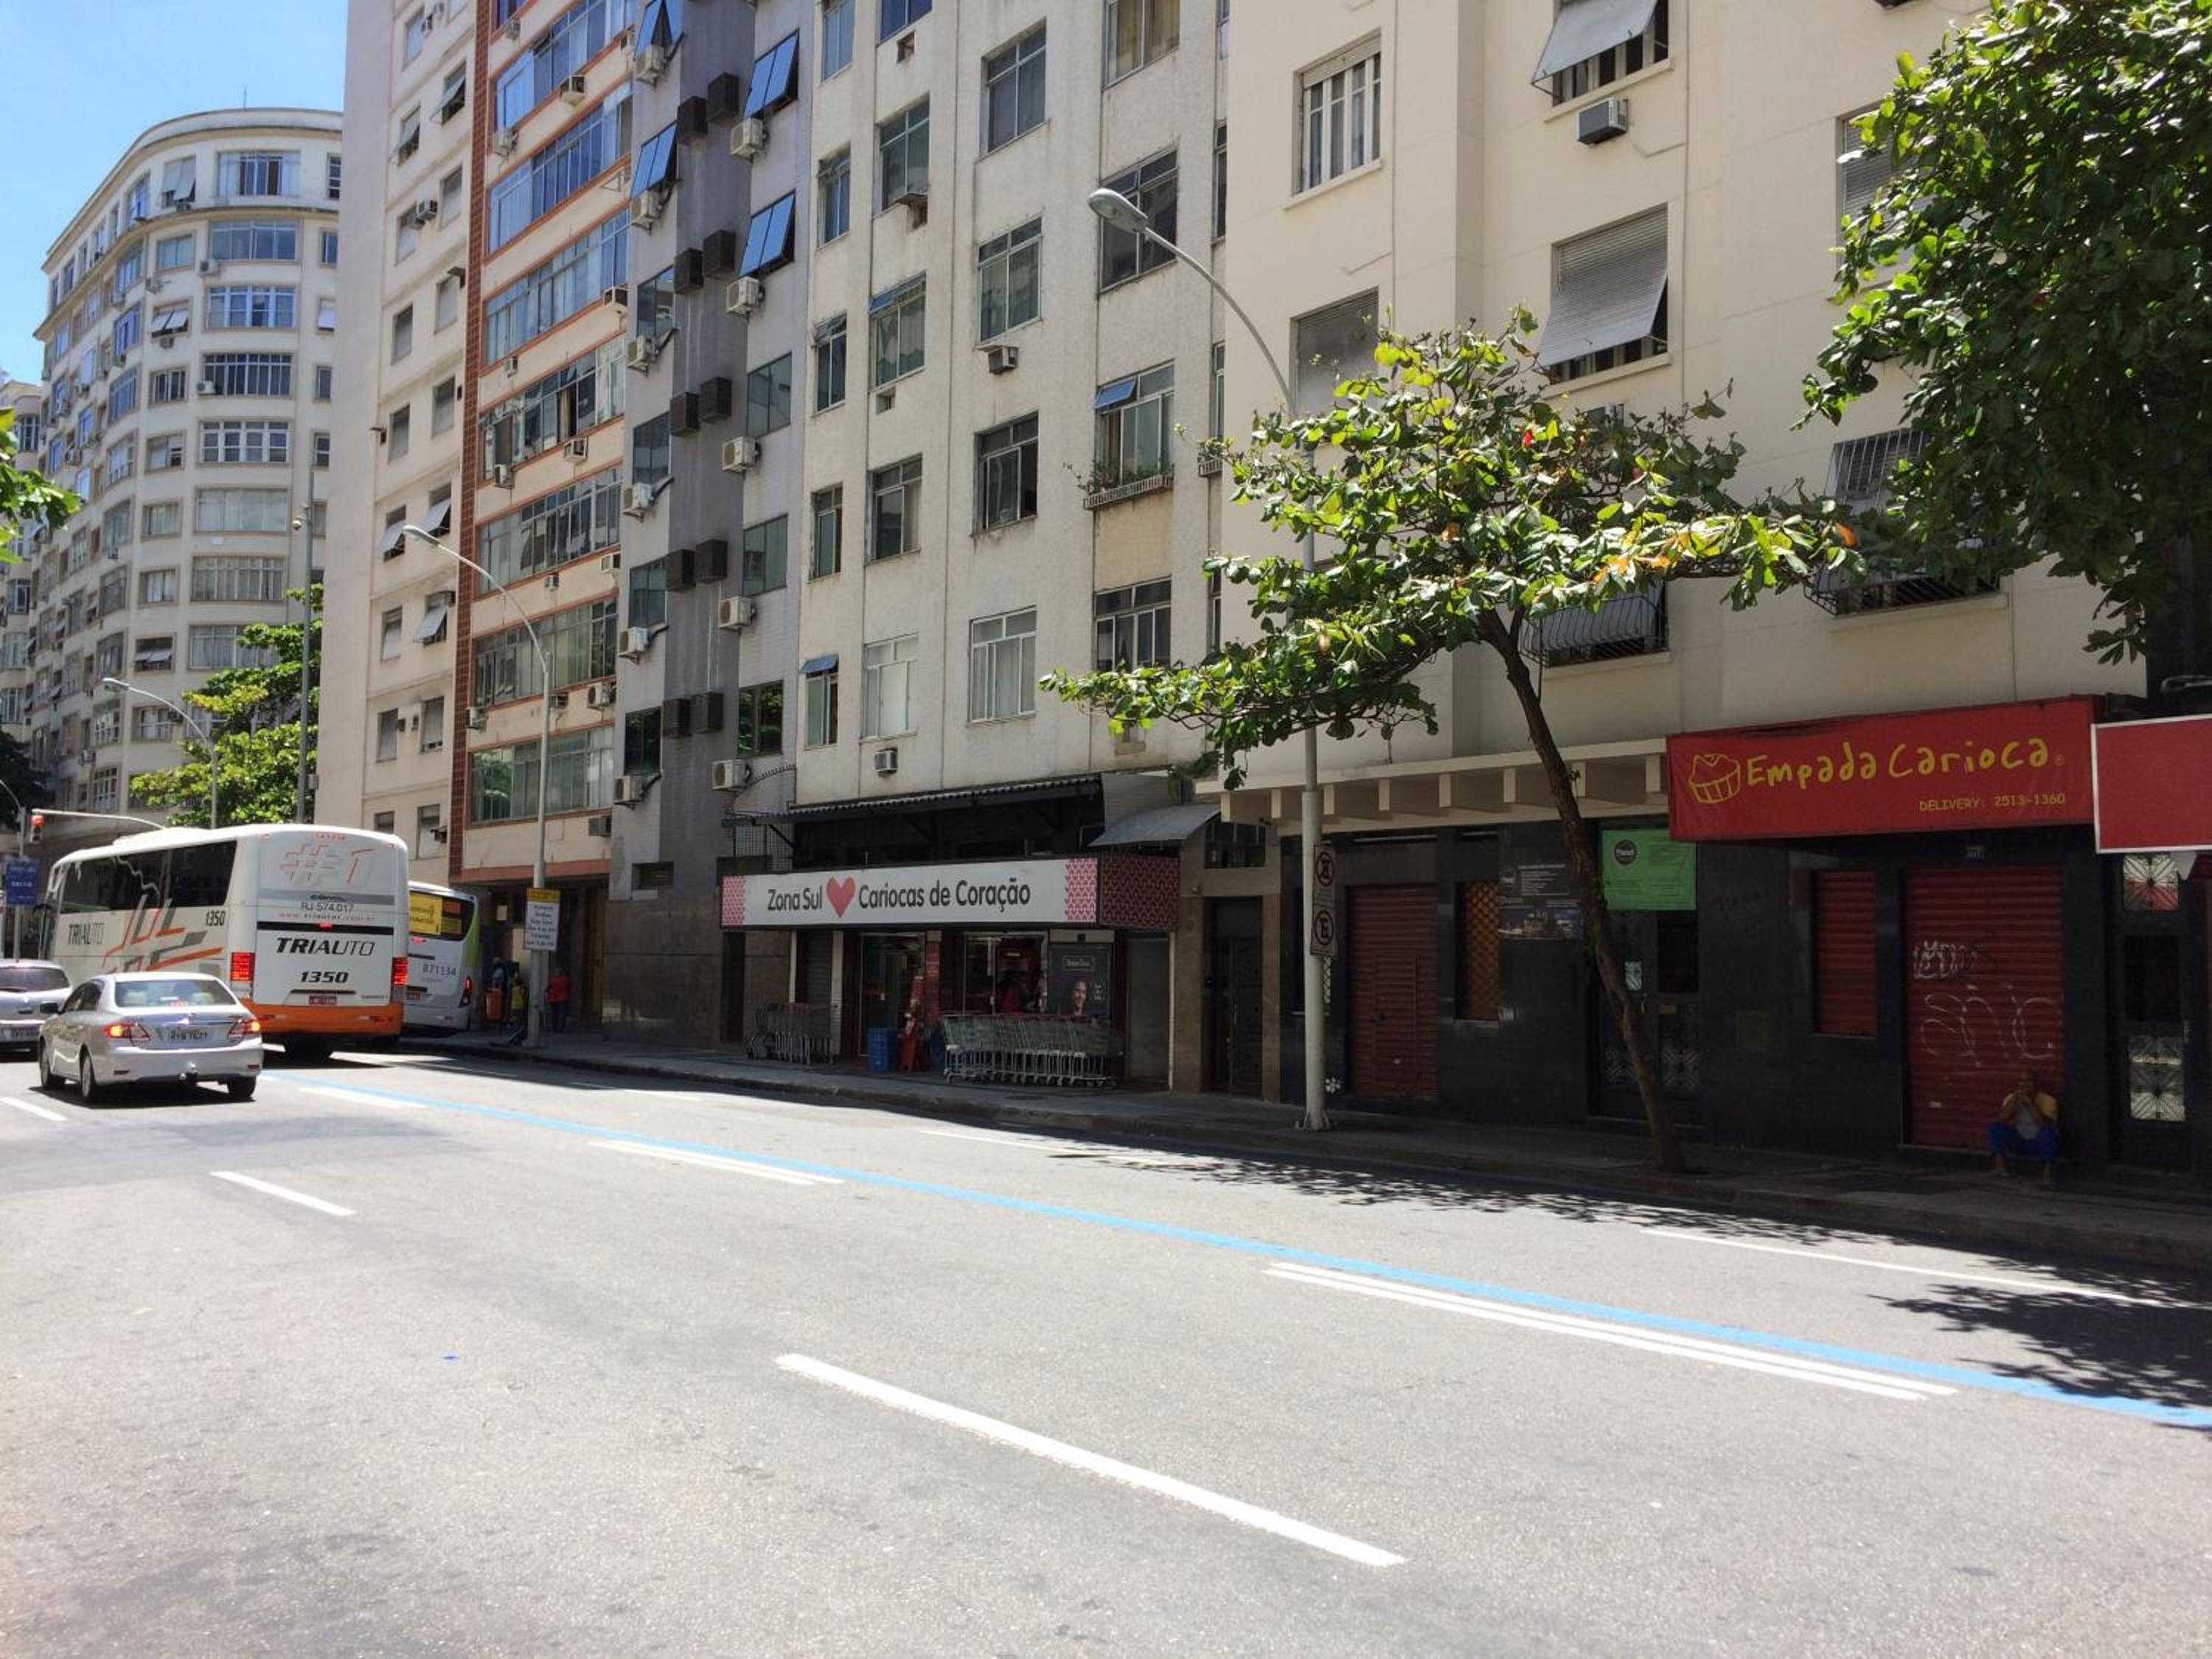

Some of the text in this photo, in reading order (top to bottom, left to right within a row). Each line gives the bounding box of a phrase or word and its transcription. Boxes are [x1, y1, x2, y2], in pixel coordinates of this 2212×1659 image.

[1746, 737, 2050, 790] Empada Carioca
[1994, 793, 2065, 807] 2513-1360
[767, 877, 1031, 913] Zona Sul Cariocas de Coração
[206, 911, 226, 927] 1350
[67, 922, 105, 945] TRIAUTO
[276, 937, 375, 956] TRIAUTO
[300, 970, 349, 984] 1350
